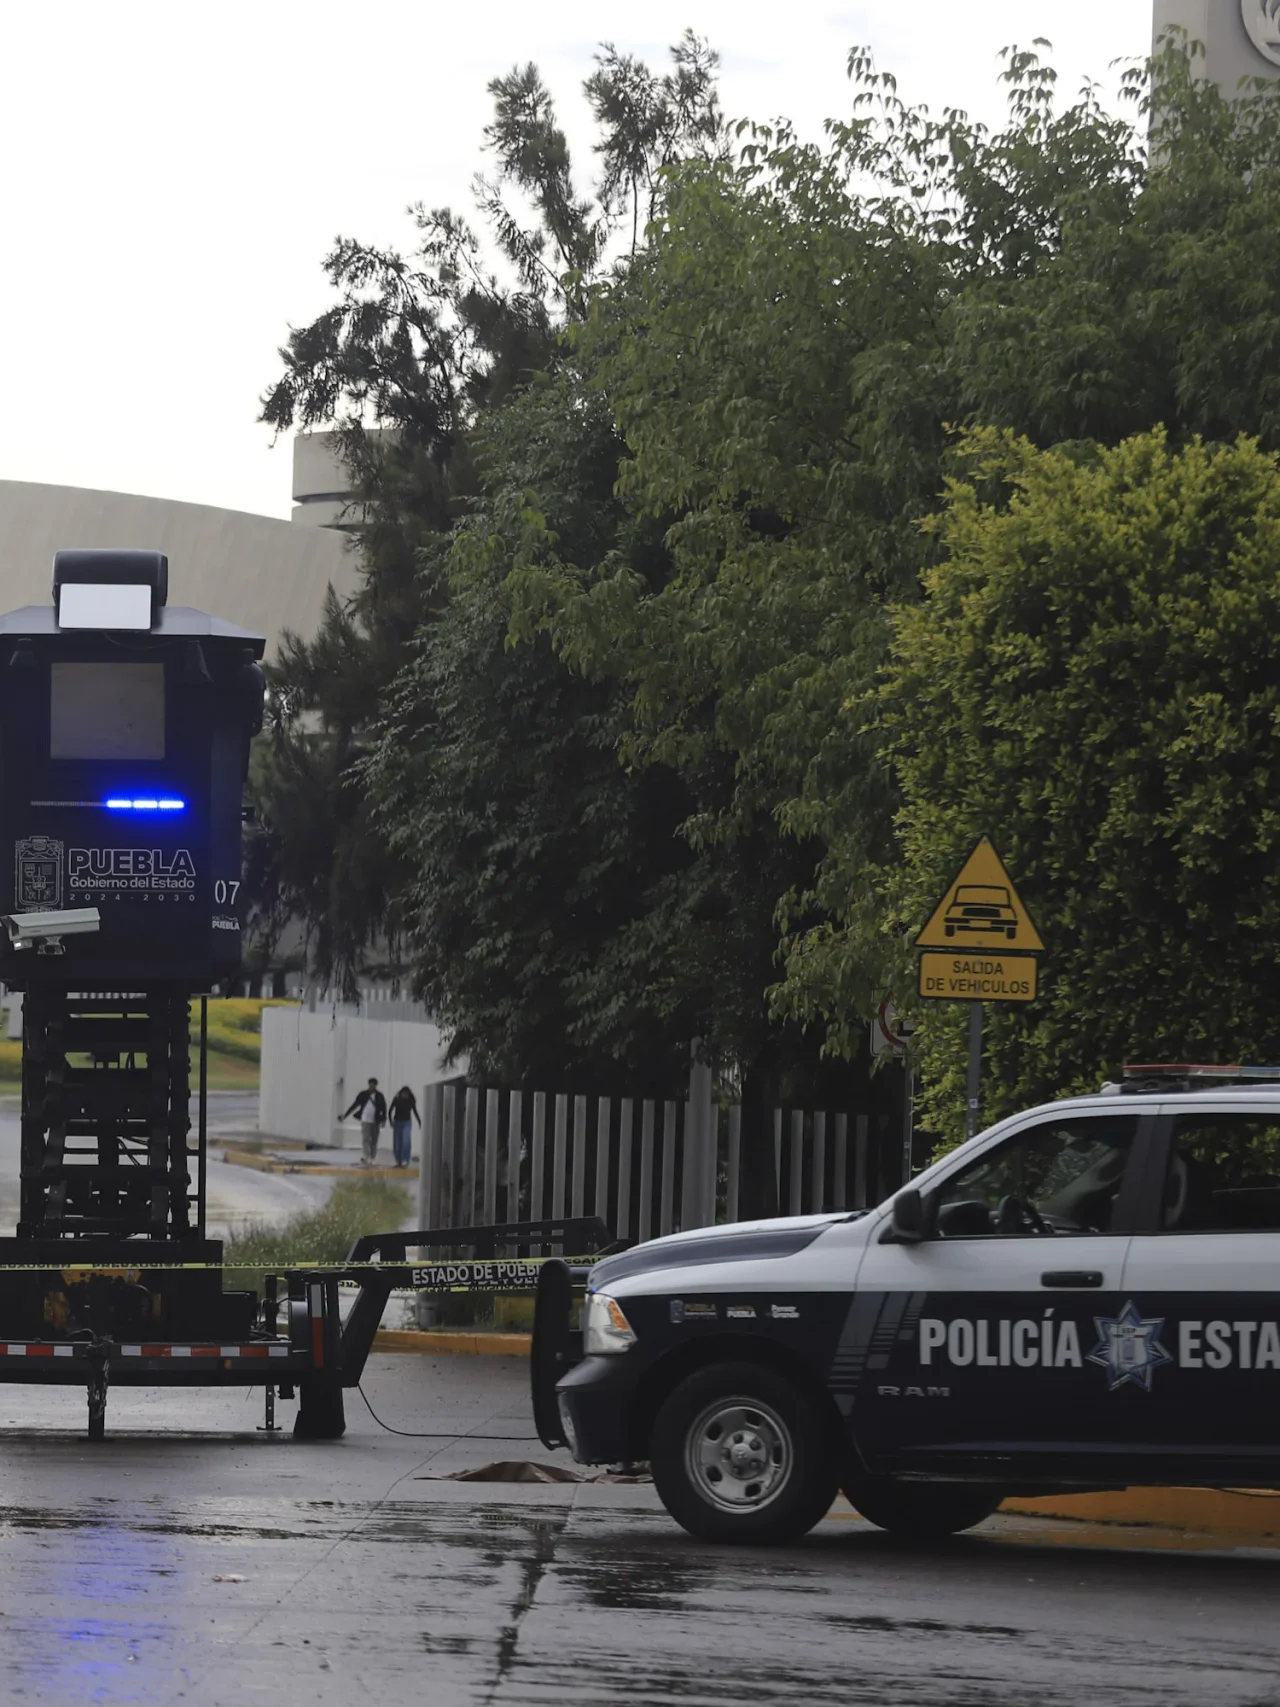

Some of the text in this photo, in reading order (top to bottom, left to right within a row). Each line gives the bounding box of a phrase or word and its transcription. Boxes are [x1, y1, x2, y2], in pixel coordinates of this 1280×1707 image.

[69, 848, 196, 876] PUEBLA
[70, 876, 195, 889] Gobierno del Estado
[215, 880, 240, 905] 07
[212, 920, 240, 930] PUEBLA
[952, 960, 1004, 975] SALIDA
[926, 977, 1030, 994] DE VEHICULOS
[412, 1266, 469, 1285] ESTADO
[473, 1265, 493, 1280] DE
[920, 1308, 1083, 1368] POLICÍA
[877, 1385, 950, 1397] RAM
